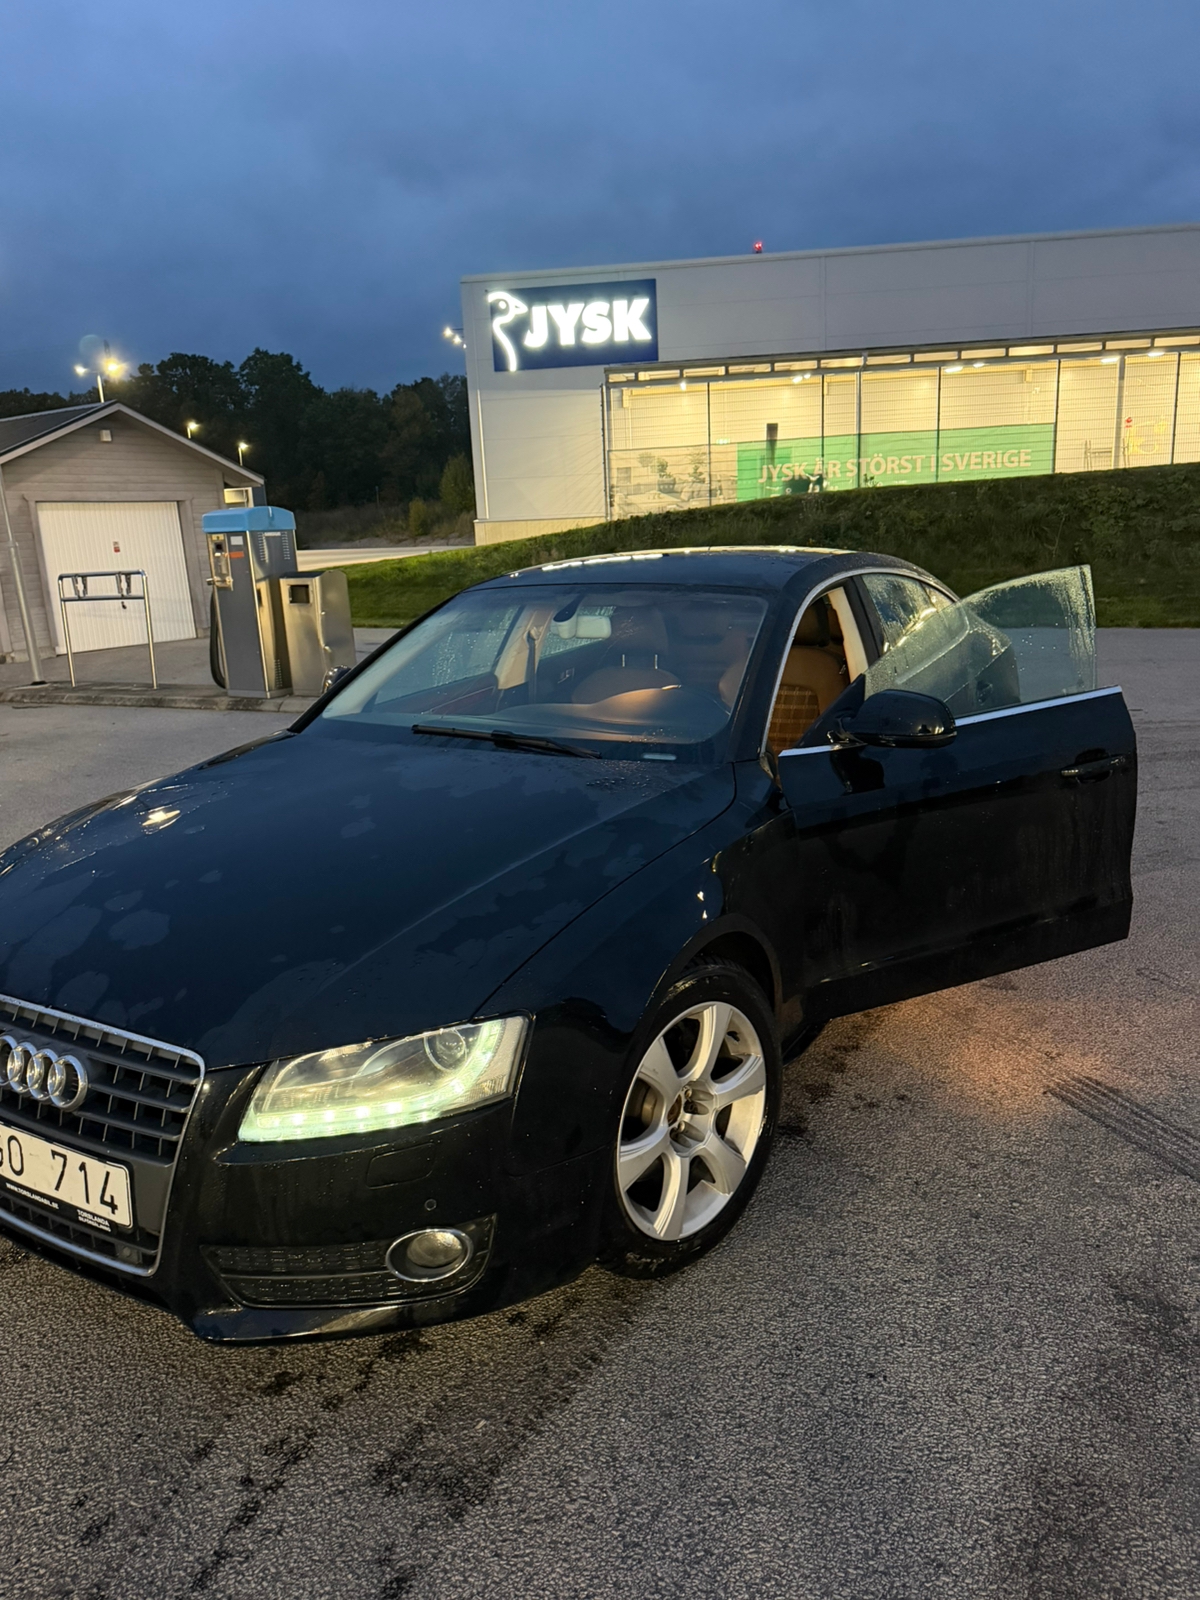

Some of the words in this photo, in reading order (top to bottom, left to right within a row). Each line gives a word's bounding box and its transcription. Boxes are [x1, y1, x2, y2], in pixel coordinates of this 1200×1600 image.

[524, 298, 652, 348] JYSK
[758, 462, 808, 483] JYSK
[813, 457, 842, 479] ÄR
[846, 453, 925, 478] STÖRST
[930, 454, 936, 472] I
[941, 449, 1032, 472] SVERIGE
[0, 1133, 24, 1176] O
[51, 1149, 118, 1215] 714
